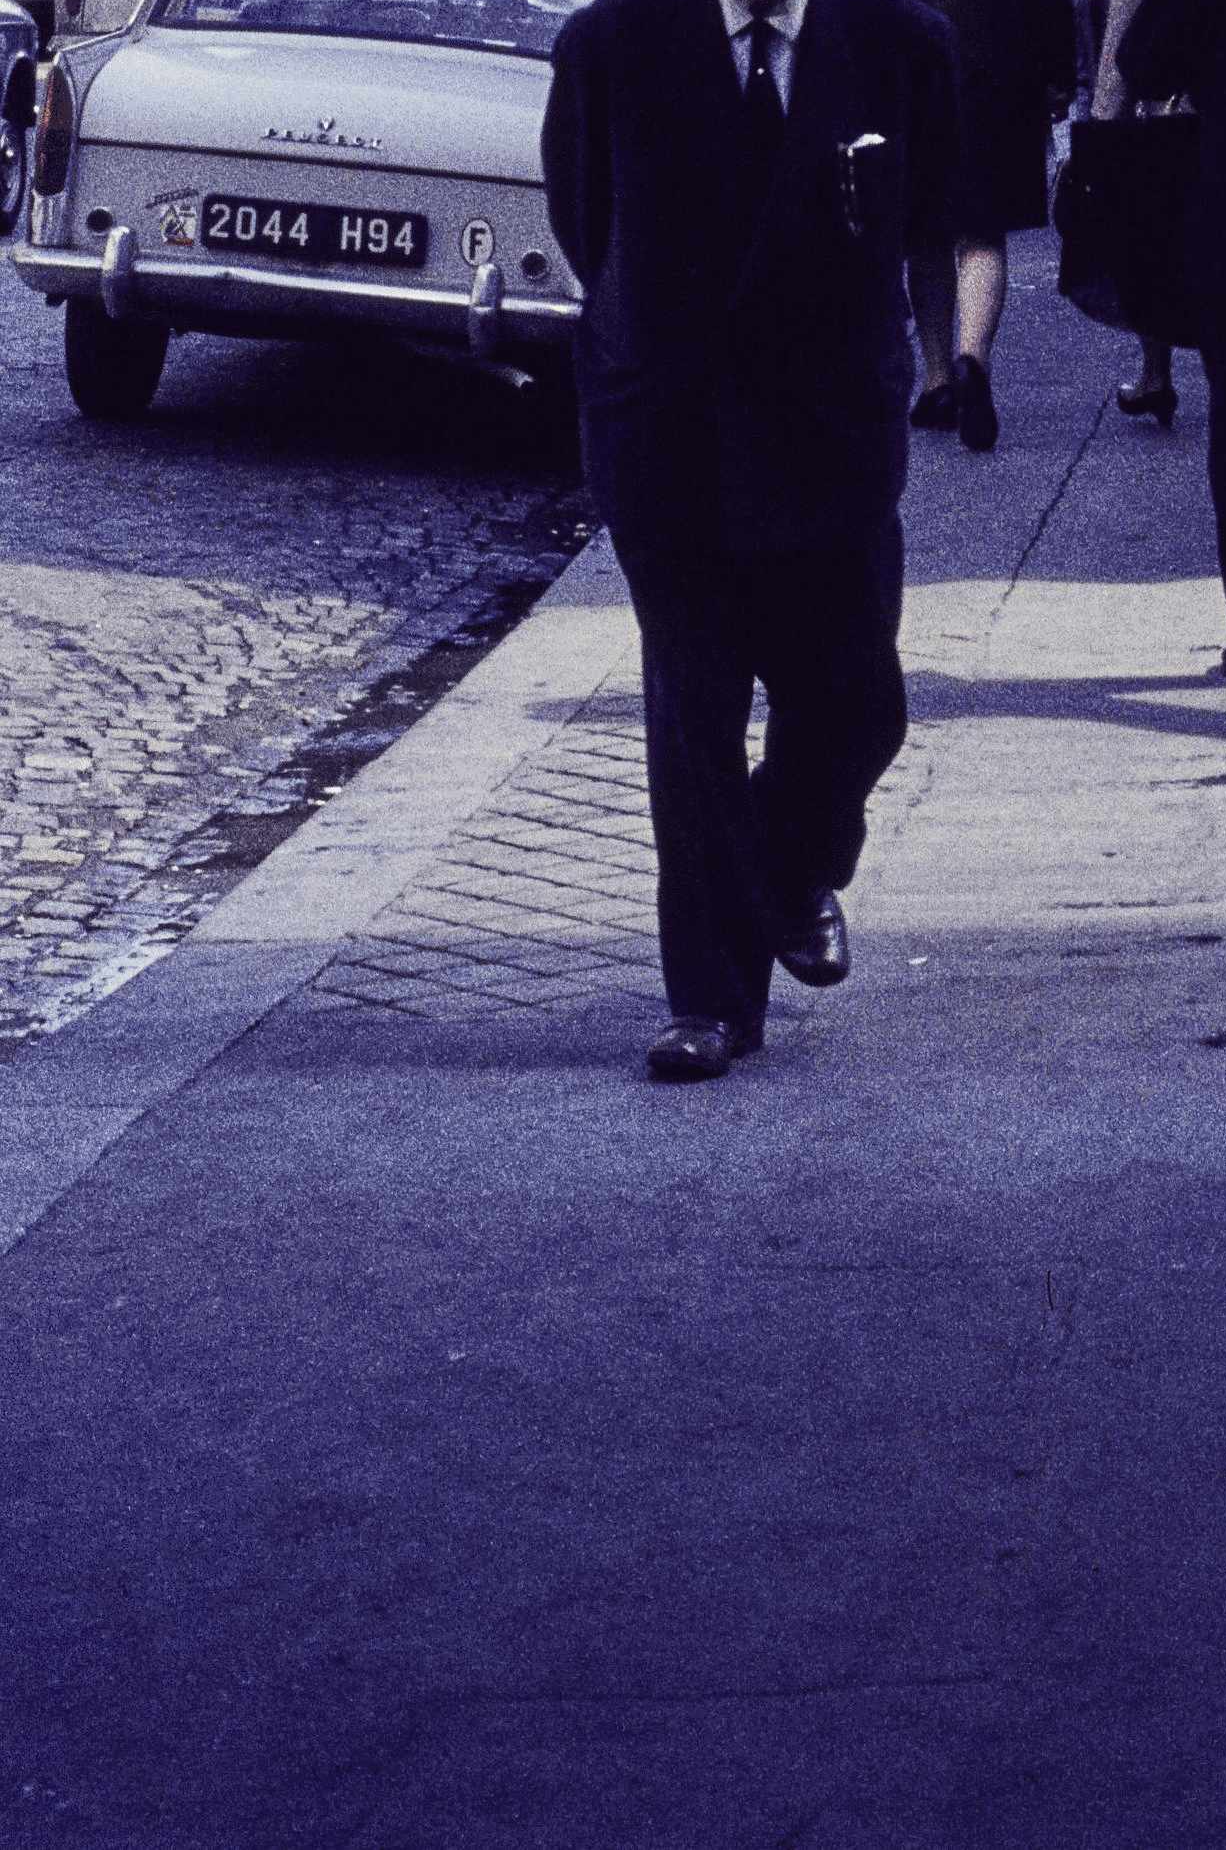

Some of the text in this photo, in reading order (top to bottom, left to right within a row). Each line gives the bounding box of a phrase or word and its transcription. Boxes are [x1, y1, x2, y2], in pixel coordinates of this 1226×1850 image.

[209, 203, 414, 255] 2044 H94
[469, 225, 488, 261] F
